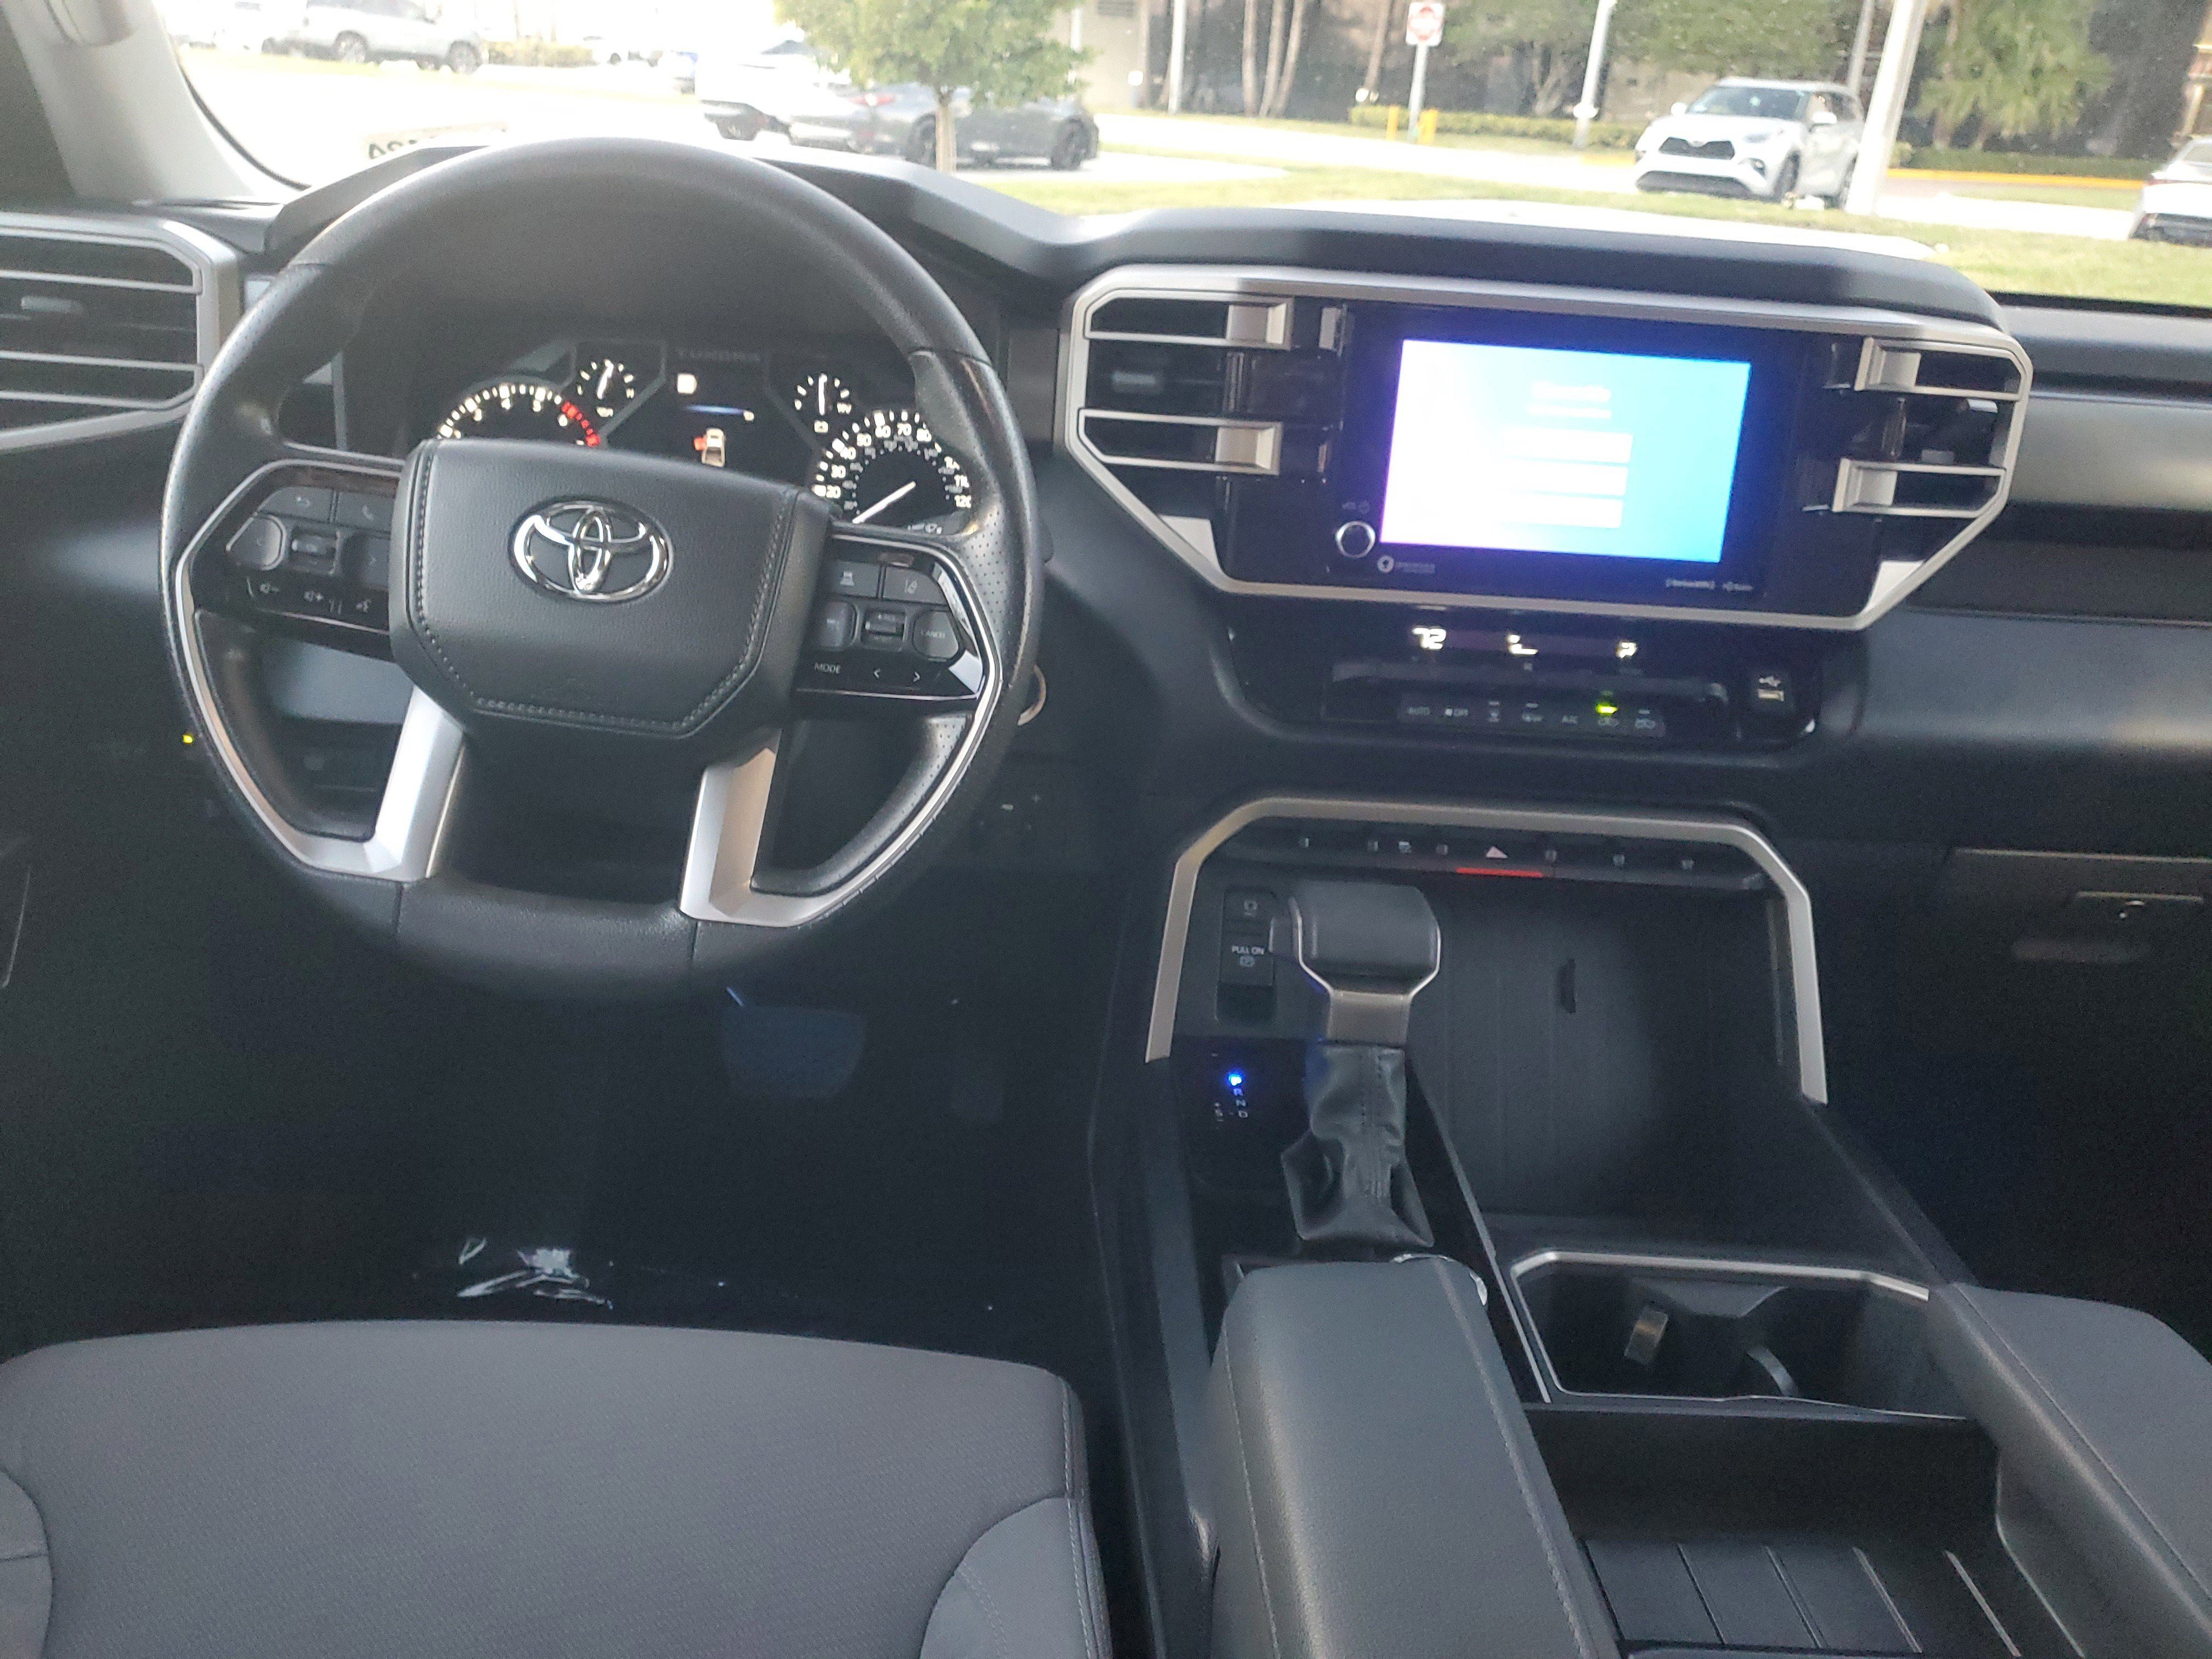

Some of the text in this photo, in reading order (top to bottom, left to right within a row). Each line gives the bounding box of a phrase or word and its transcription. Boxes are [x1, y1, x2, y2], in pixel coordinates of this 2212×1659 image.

[897, 422, 912, 436] 70
[826, 484, 841, 499] 20
[1412, 627, 1447, 650] 72
[814, 662, 842, 674] MODE
[1232, 945, 1264, 955] PULL ON
[1234, 1088, 1244, 1096] R
